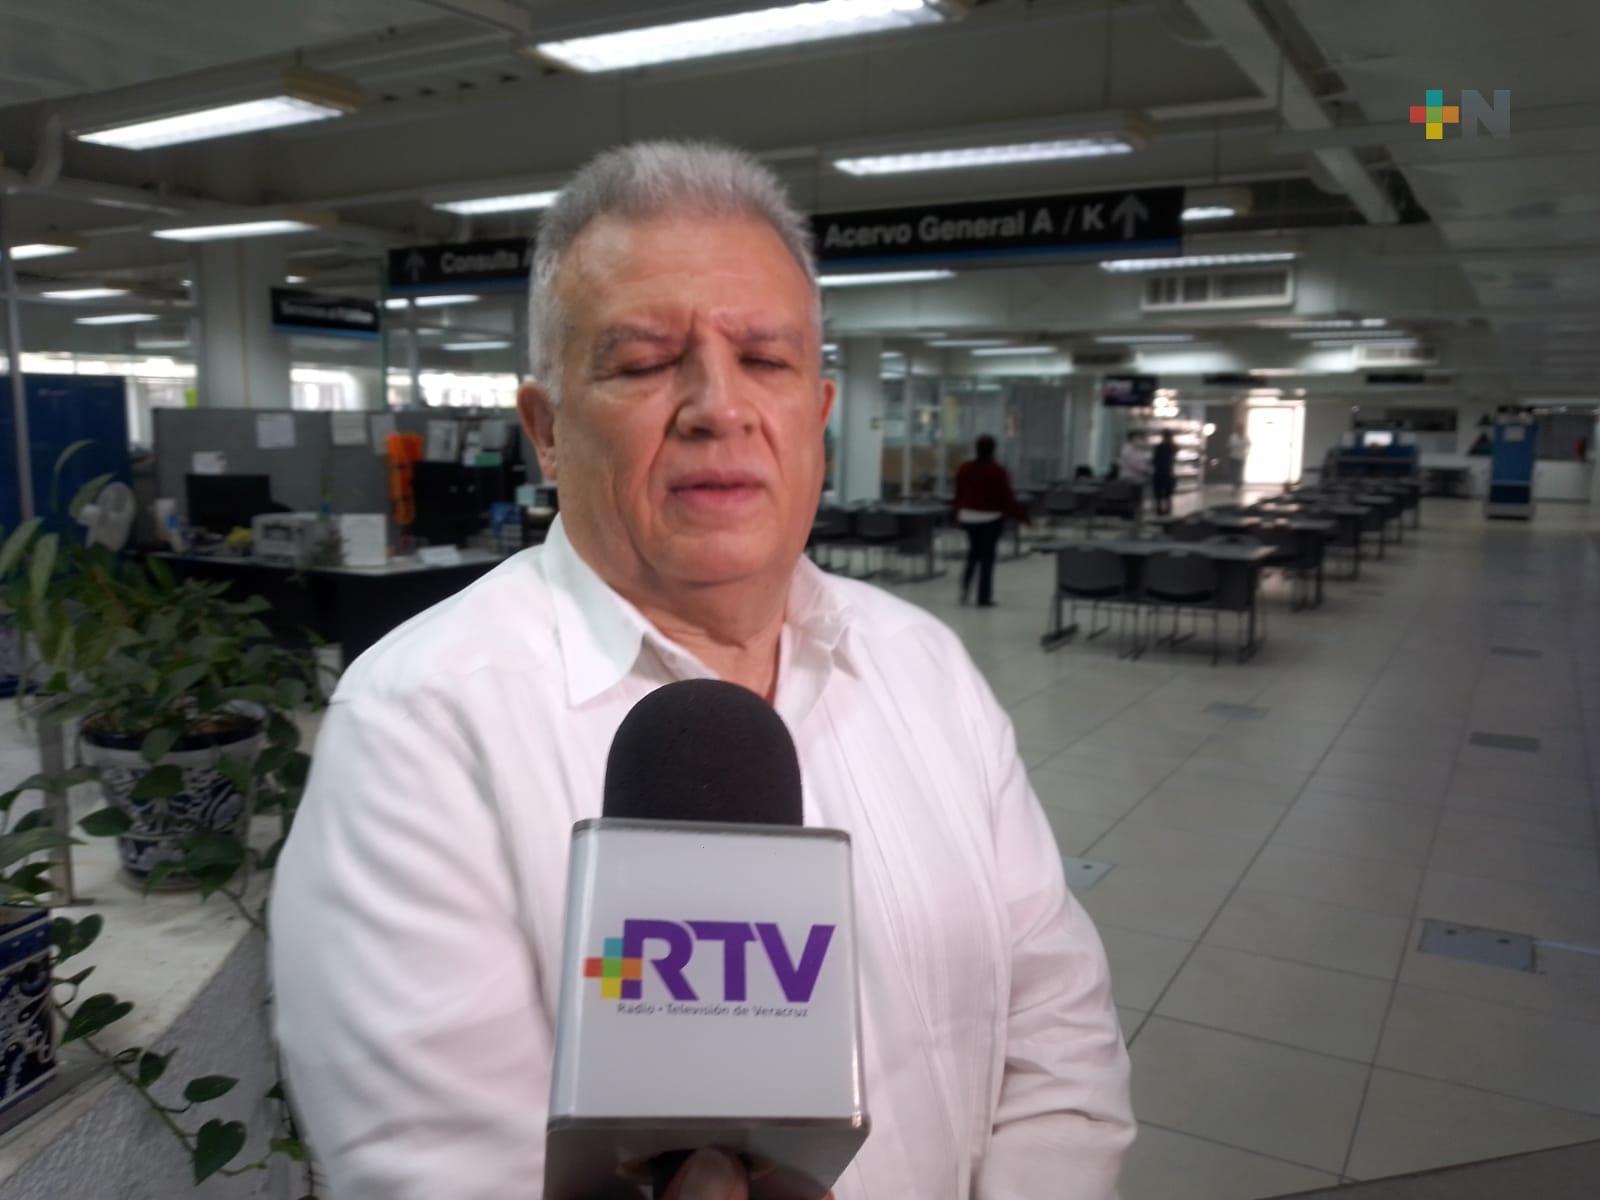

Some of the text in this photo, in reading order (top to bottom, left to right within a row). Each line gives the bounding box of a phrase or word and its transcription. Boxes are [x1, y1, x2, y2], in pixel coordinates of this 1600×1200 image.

[824, 223, 913, 248] Acervo
[918, 210, 1026, 242] General
[1031, 207, 1054, 234] A
[1081, 202, 1105, 231] K
[441, 249, 519, 273] Consulta
[621, 918, 836, 1003] RTV
[617, 1002, 809, 1018] Radio Televisión de Veracruz
